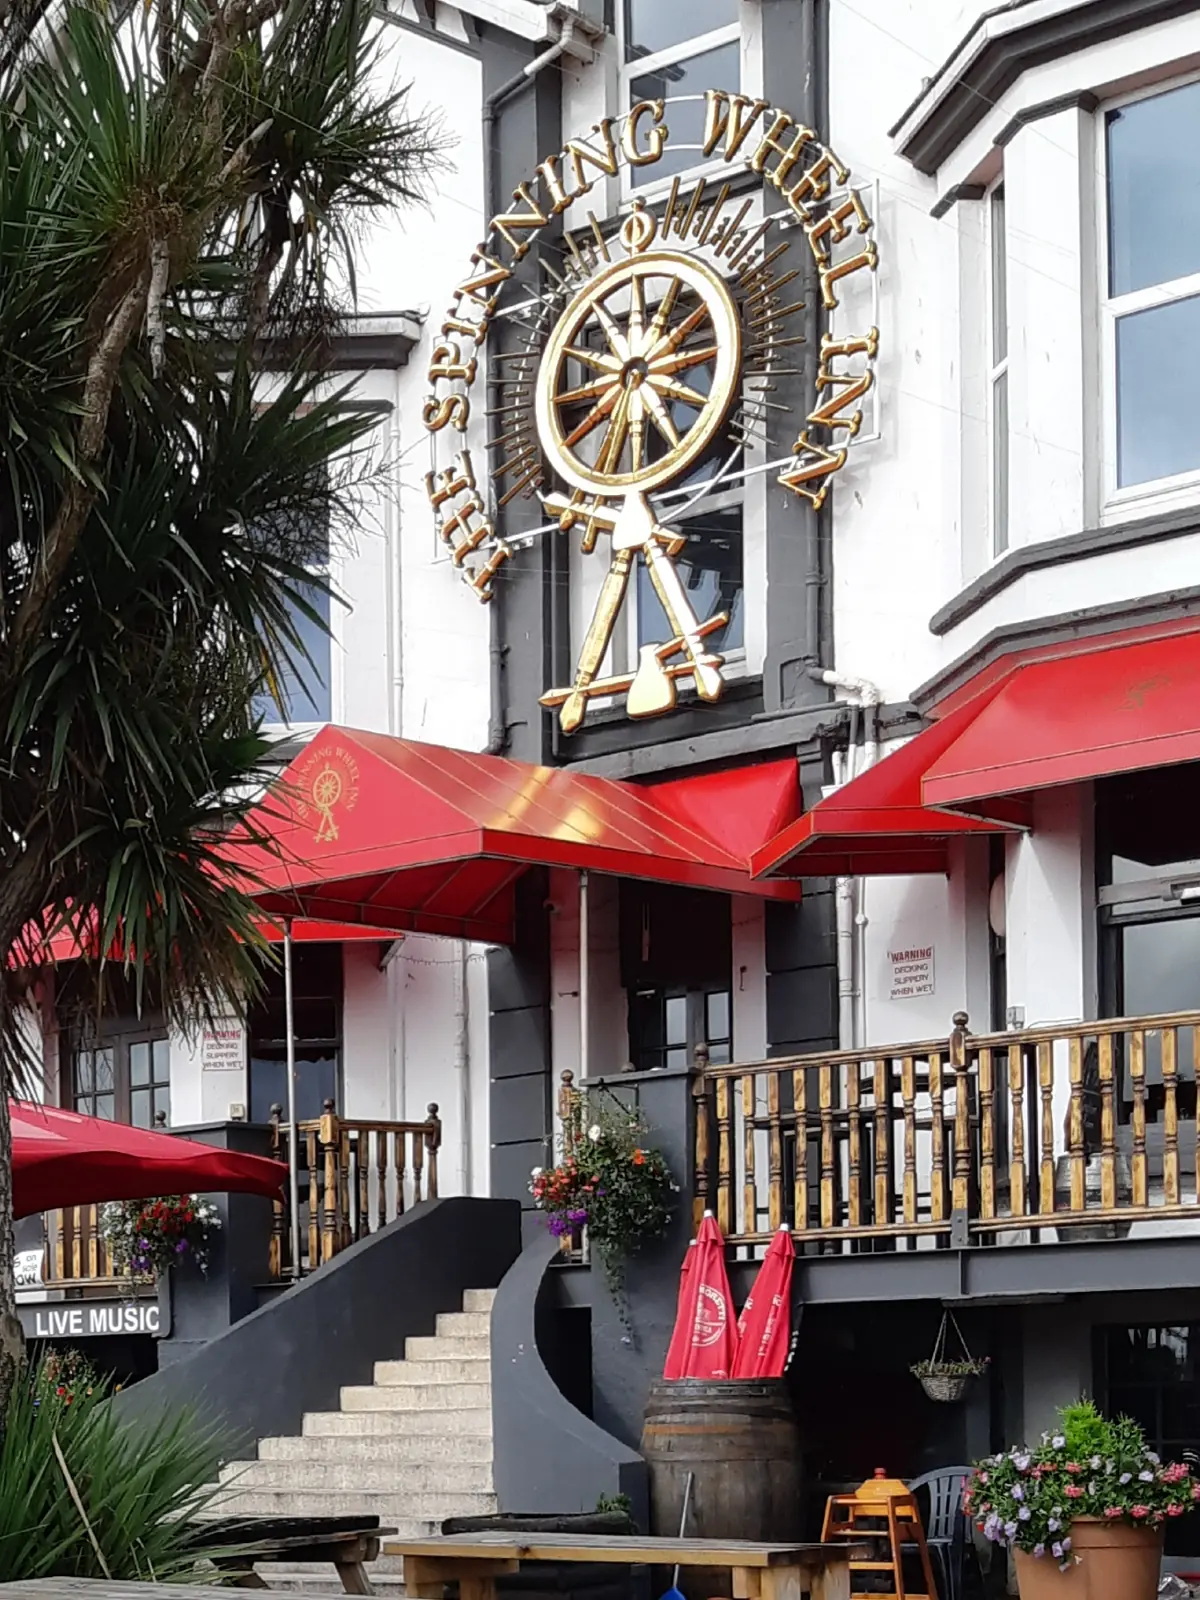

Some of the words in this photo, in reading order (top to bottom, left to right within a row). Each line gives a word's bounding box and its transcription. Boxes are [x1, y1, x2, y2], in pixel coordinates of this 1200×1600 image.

[703, 88, 877, 309] WHEEL
[422, 98, 668, 432] SPINNING
[777, 326, 880, 510] INN
[425, 450, 514, 603] THE
[891, 947, 932, 963] WARNING
[894, 963, 928, 974] DECKING
[894, 974, 929, 985] SLIPPERY
[891, 986, 913, 995] WHEN
[916, 984, 932, 992] WET
[14, 1273, 37, 1286] OW
[36, 1310, 82, 1335] LIVE
[89, 1306, 160, 1333] MUSIC
